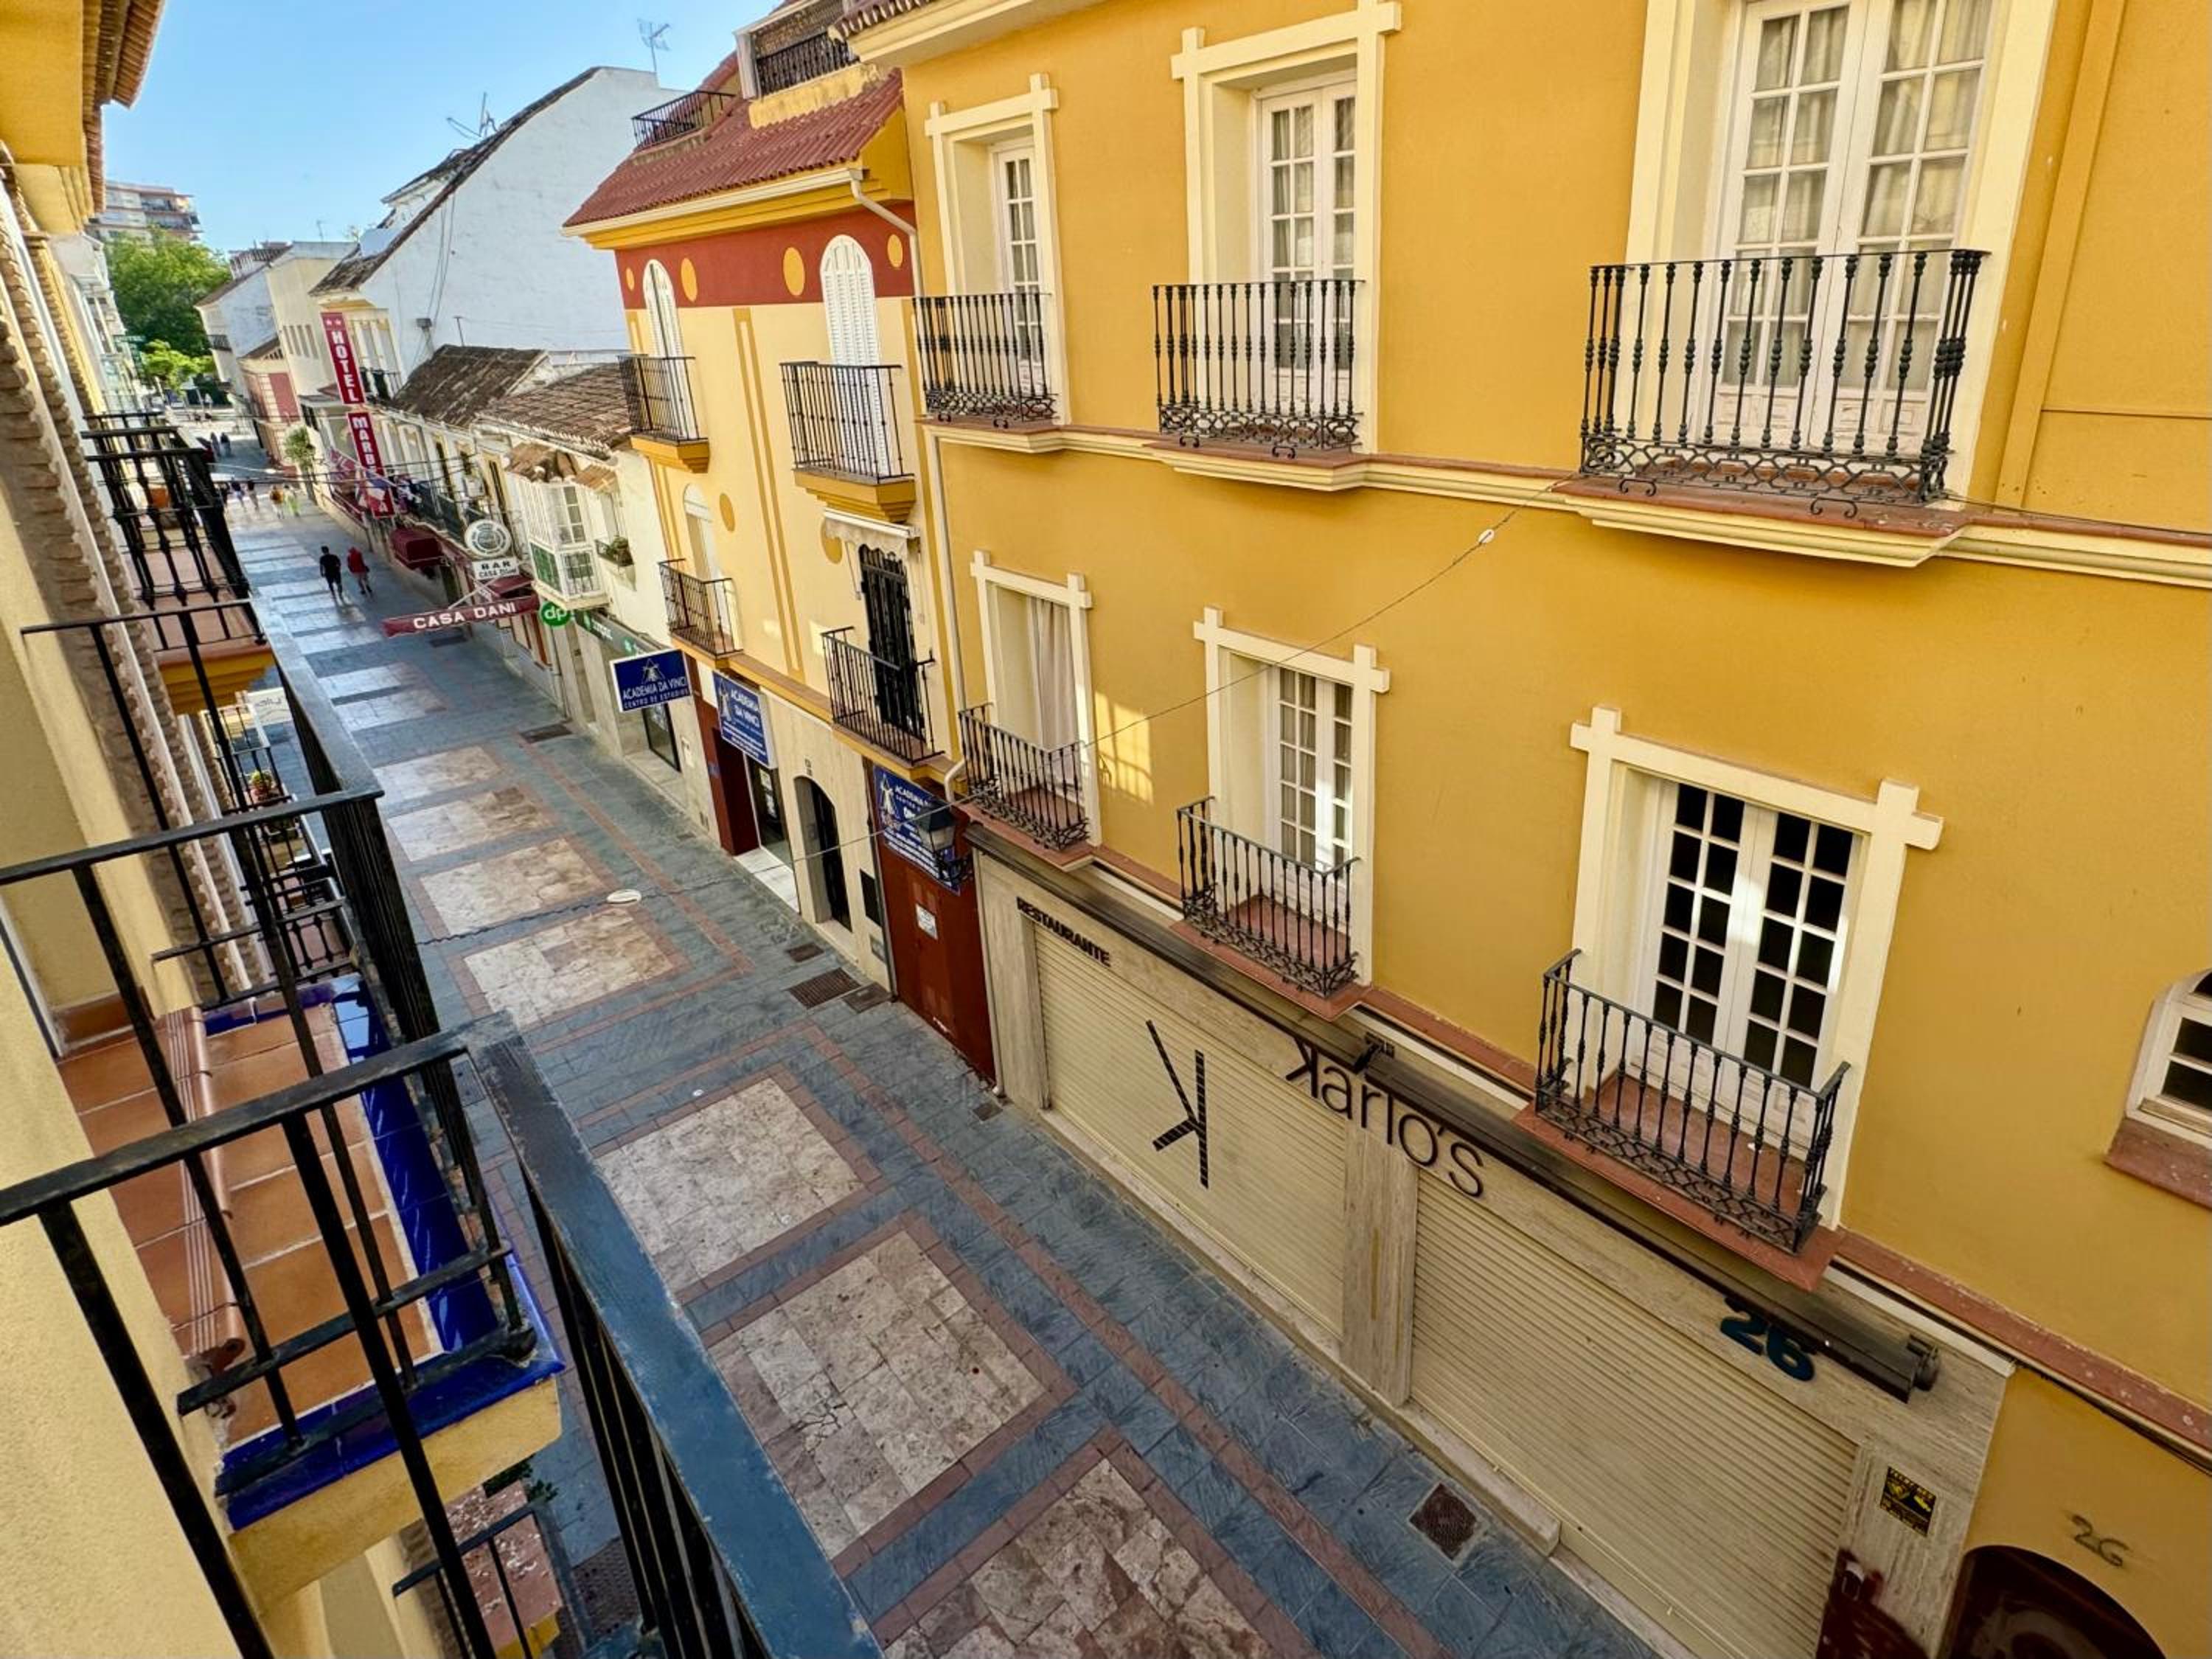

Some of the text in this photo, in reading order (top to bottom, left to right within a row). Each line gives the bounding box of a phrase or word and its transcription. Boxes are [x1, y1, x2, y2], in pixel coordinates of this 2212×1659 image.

[332, 330, 359, 402] HOTEL
[481, 560, 511, 570] BAR
[413, 602, 516, 629] CASA DANI
[623, 676, 686, 700] ACADEMIA DA VINCI
[731, 689, 759, 712] ACADEMIA
[625, 697, 648, 709] CENTRO
[1016, 896, 1110, 967] RESTAURANTE
[1720, 1297, 1816, 1381] 26
